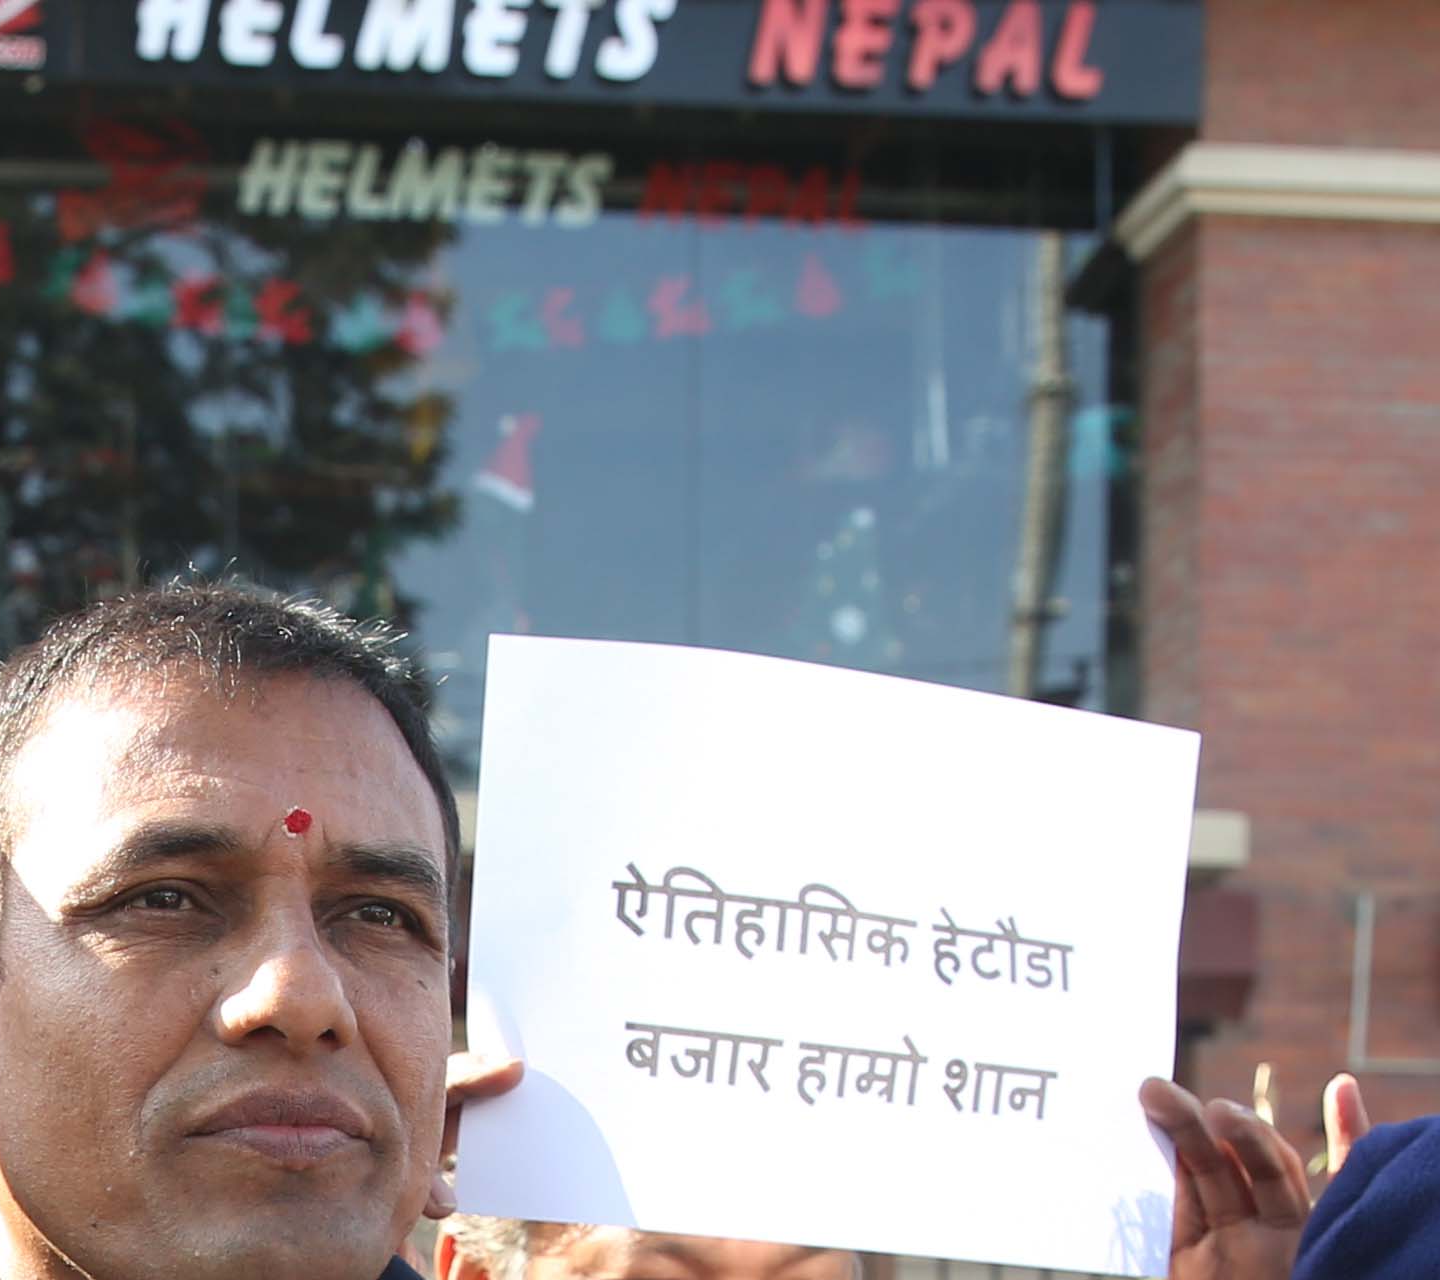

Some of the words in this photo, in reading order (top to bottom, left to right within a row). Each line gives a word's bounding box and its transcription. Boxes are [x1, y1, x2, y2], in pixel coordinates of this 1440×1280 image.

[135, 0, 675, 82] HELMETS
[749, 0, 1105, 99] NEPAL
[238, 138, 616, 228] HELMETS
[637, 160, 868, 230] NEPAL
[611, 861, 918, 967] ऐतिहासिक
[624, 1021, 784, 1093] बजार
[797, 1035, 929, 1106] हाम्रो
[942, 1058, 1058, 1120] शान
